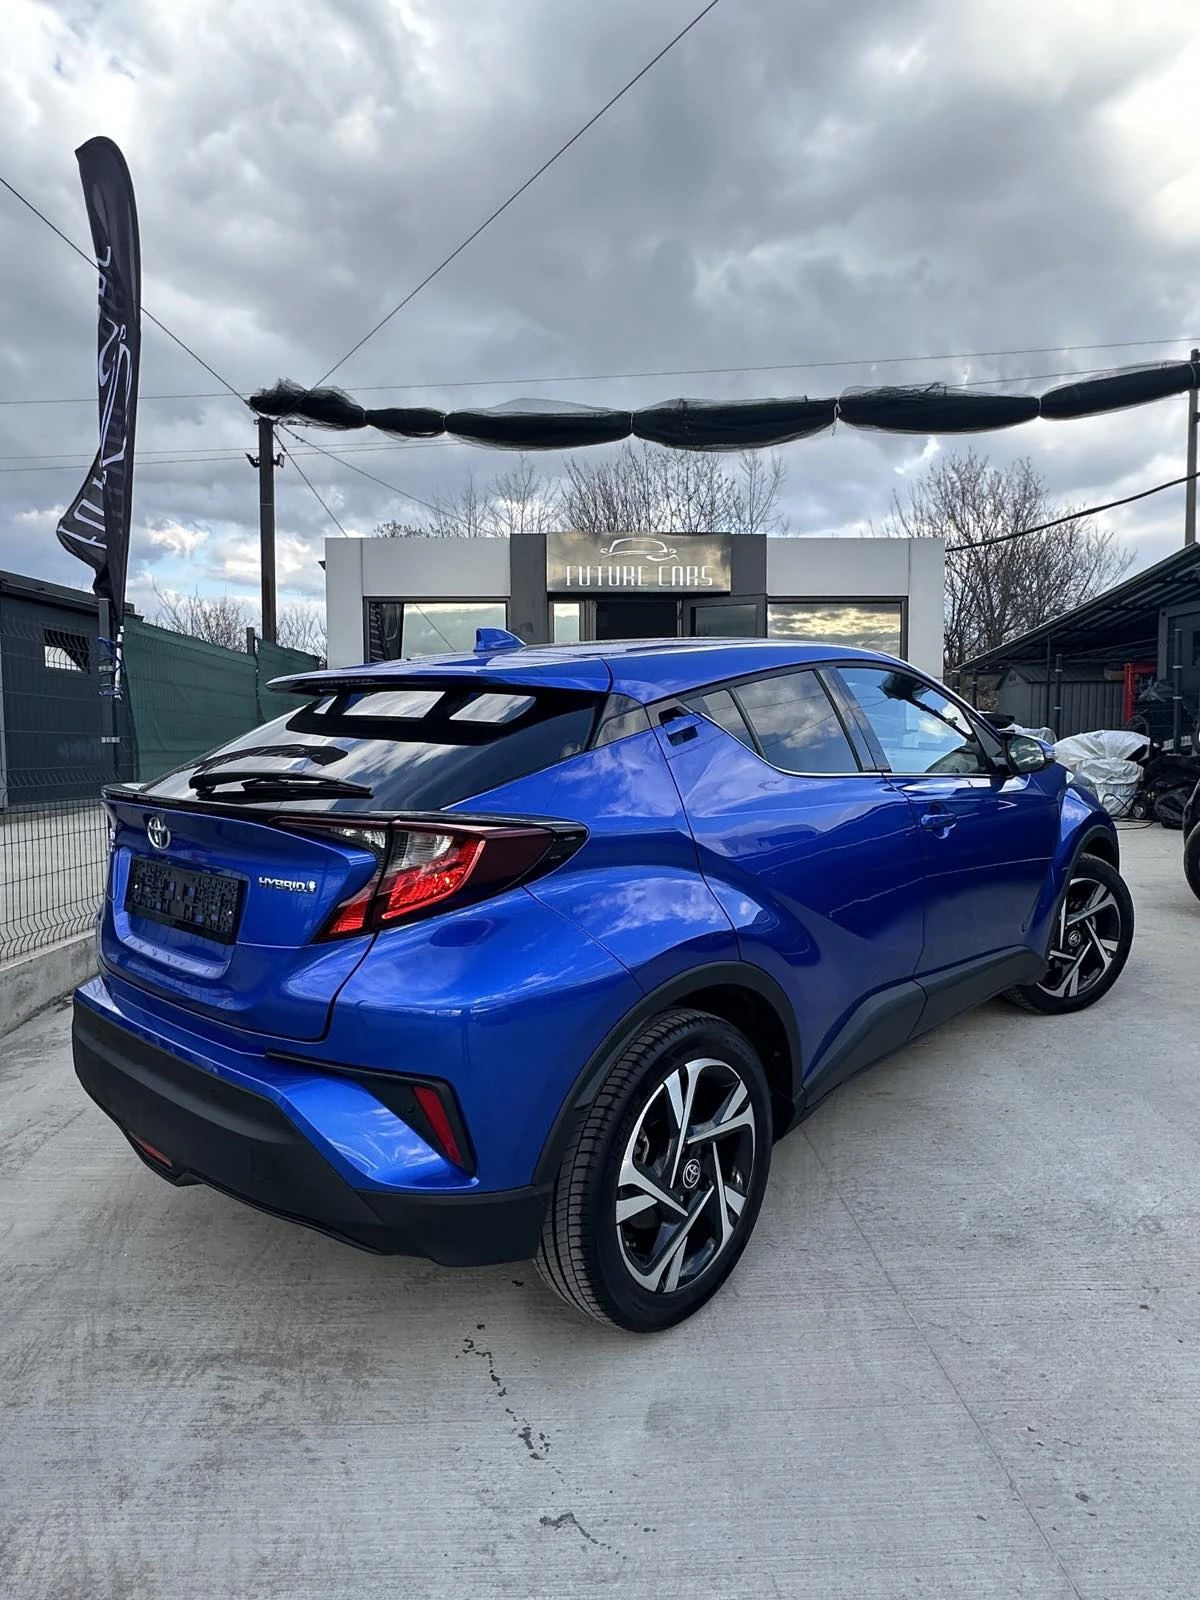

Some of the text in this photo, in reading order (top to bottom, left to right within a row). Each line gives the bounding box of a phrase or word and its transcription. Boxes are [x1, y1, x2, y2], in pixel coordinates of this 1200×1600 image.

[566, 565, 713, 587] FUTURE CARS
[258, 876, 308, 893] HYBRID
